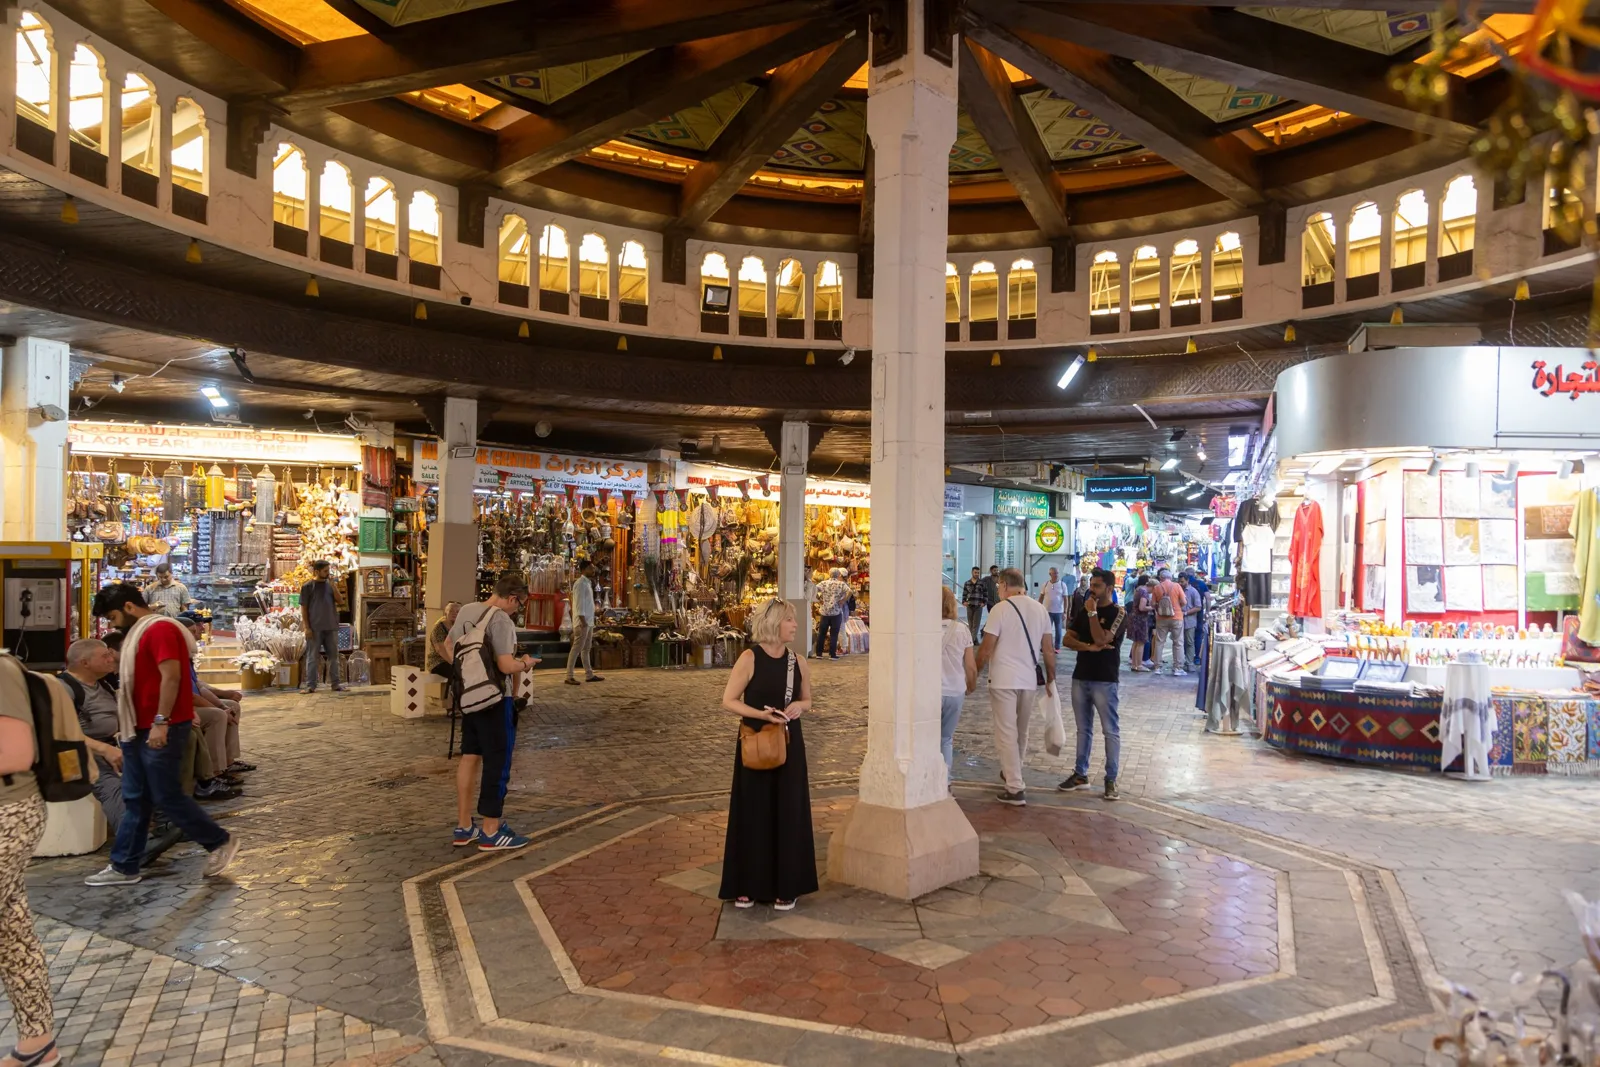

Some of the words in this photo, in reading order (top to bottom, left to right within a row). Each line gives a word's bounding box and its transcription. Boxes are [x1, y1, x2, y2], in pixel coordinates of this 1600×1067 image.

[67, 434, 130, 446] BLACK
[136, 437, 195, 449] PEARL
[202, 440, 307, 454] INVESTMENT
[491, 449, 541, 469] CENTER
[546, 455, 601, 476] التراث
[600, 461, 644, 481] مركز
[1029, 507, 1047, 516] CORNER
